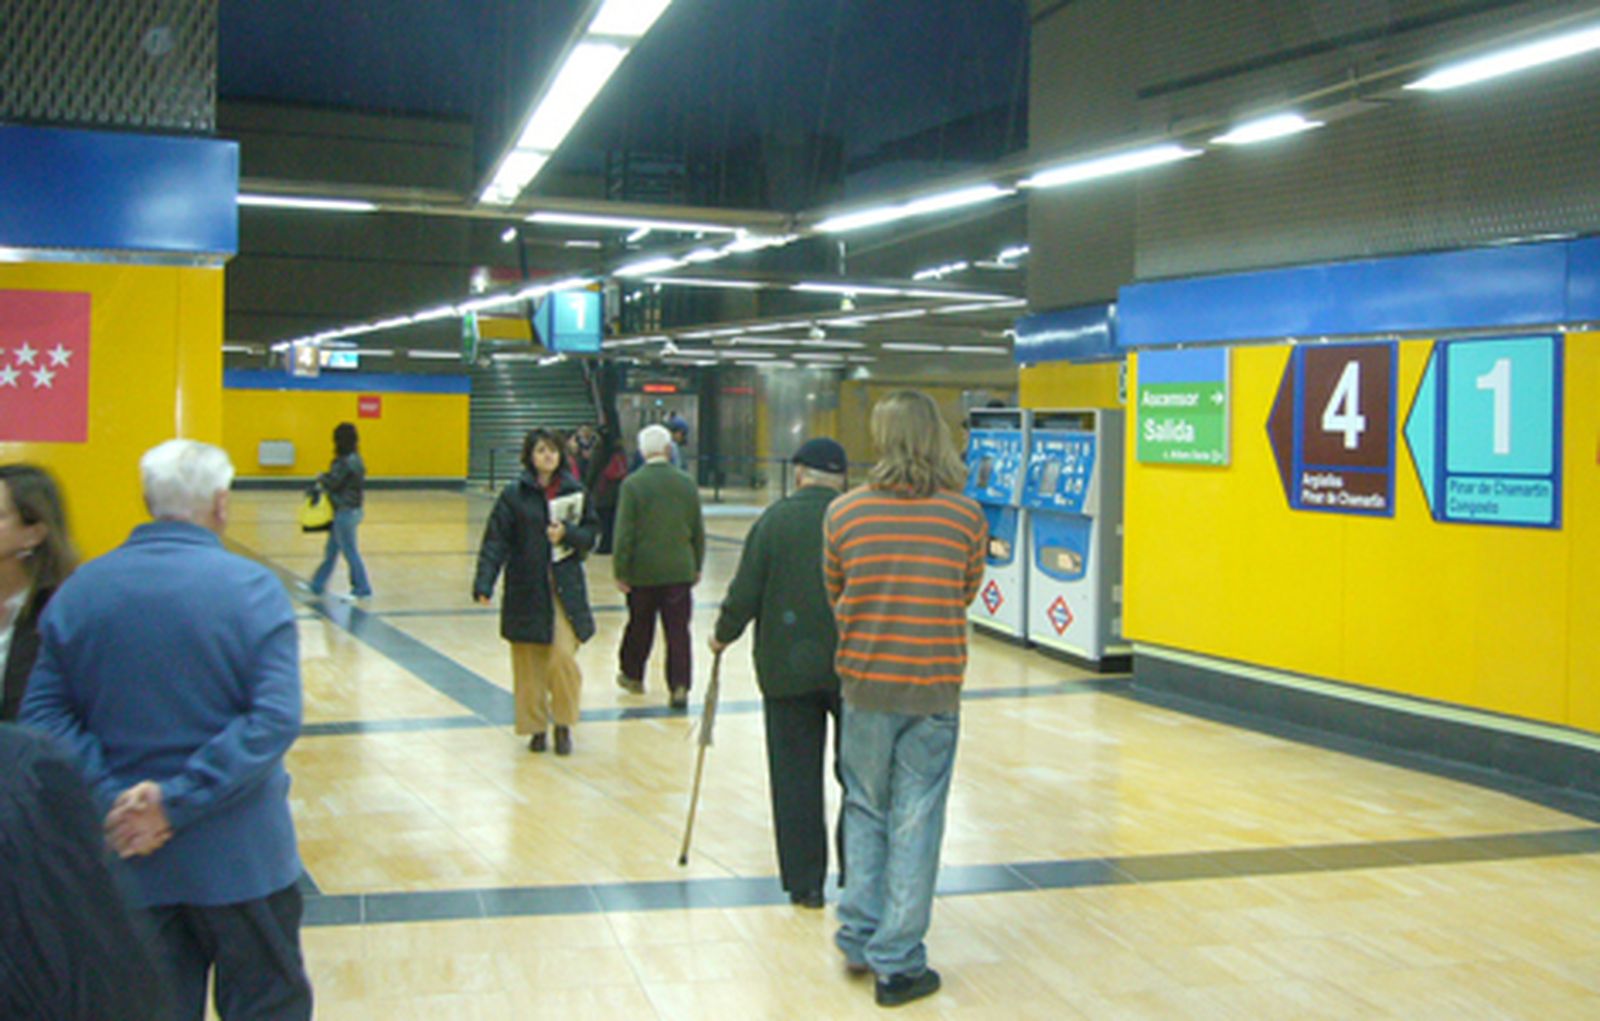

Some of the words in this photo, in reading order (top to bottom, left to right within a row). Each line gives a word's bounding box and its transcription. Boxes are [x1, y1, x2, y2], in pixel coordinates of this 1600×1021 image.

[569, 293, 588, 331] 1
[1142, 389, 1199, 408] Ascensor
[1321, 360, 1366, 450] 4
[1475, 357, 1511, 455] 1
[1143, 418, 1195, 442] Salida
[1302, 489, 1324, 505] Pinar
[1326, 491, 1337, 505] de
[1450, 479, 1474, 495] Pinar
[1478, 480, 1491, 495] de
